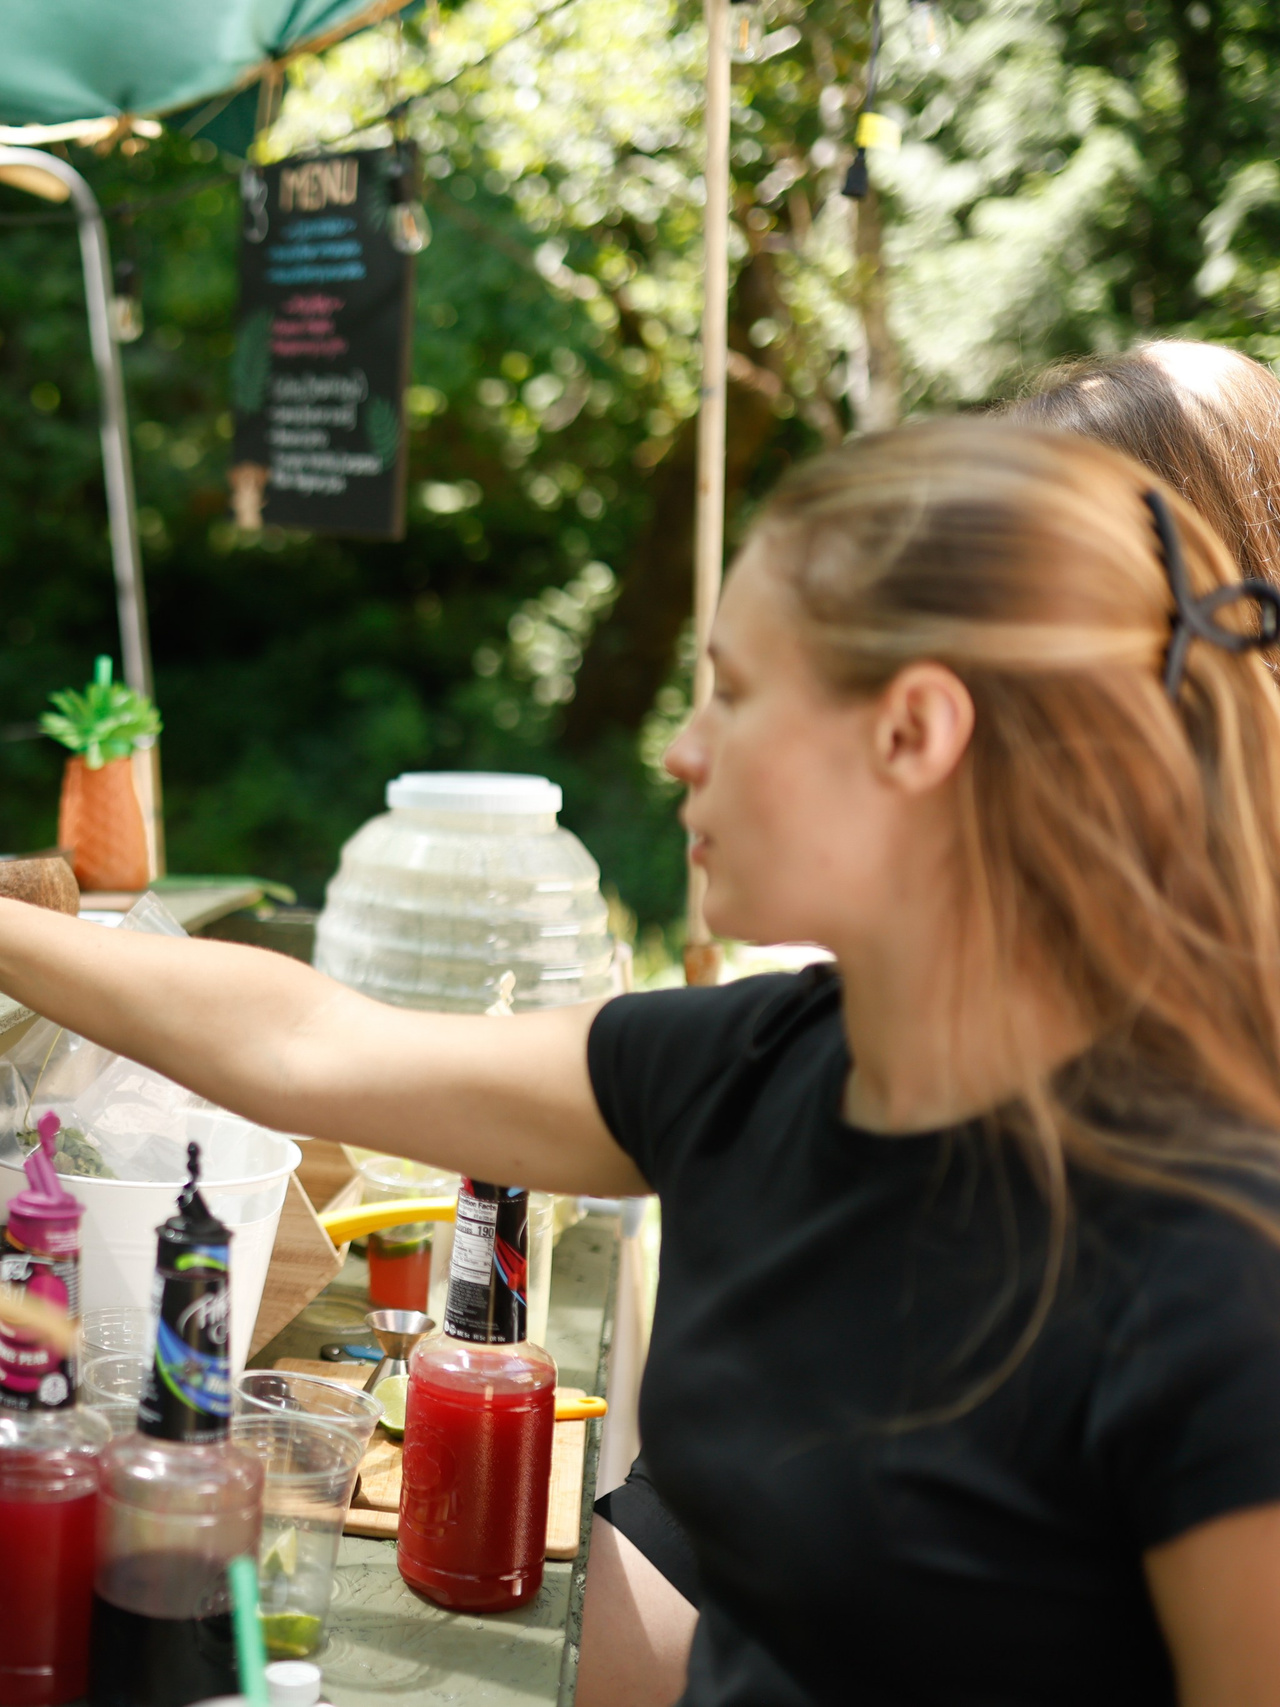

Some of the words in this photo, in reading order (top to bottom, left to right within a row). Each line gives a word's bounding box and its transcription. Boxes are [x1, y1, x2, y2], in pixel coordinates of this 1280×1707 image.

[280, 159, 358, 212] MENU
[477, 1225, 495, 1238] 190
[19, 1350, 49, 1366] PEAR
